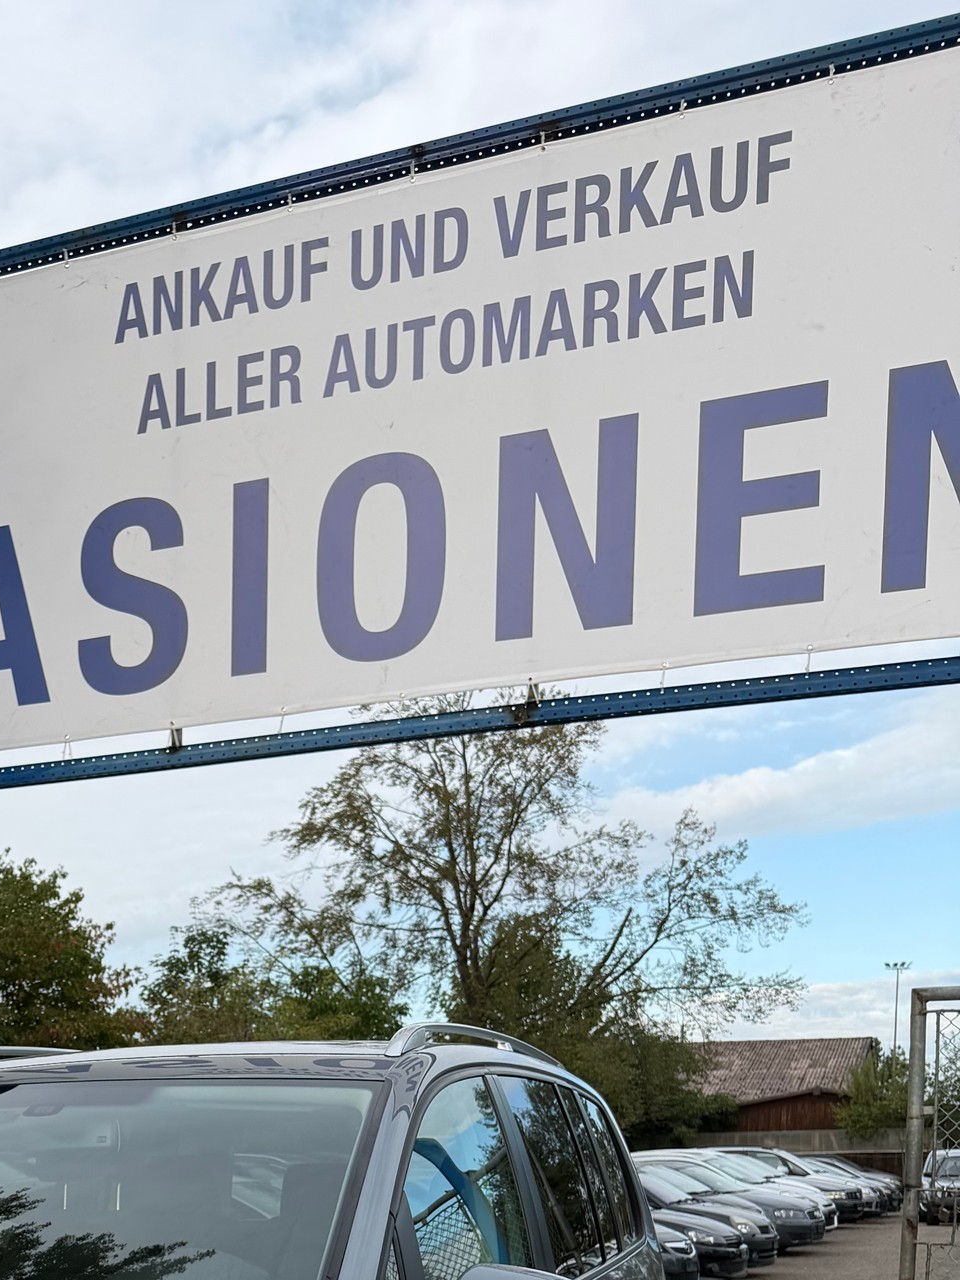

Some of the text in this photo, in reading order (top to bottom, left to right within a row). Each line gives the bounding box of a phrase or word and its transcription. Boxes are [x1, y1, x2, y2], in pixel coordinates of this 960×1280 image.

[115, 130, 793, 345] ANKAUF UND VERKAUF
[137, 249, 755, 435] ALLER AUTOMARKEN
